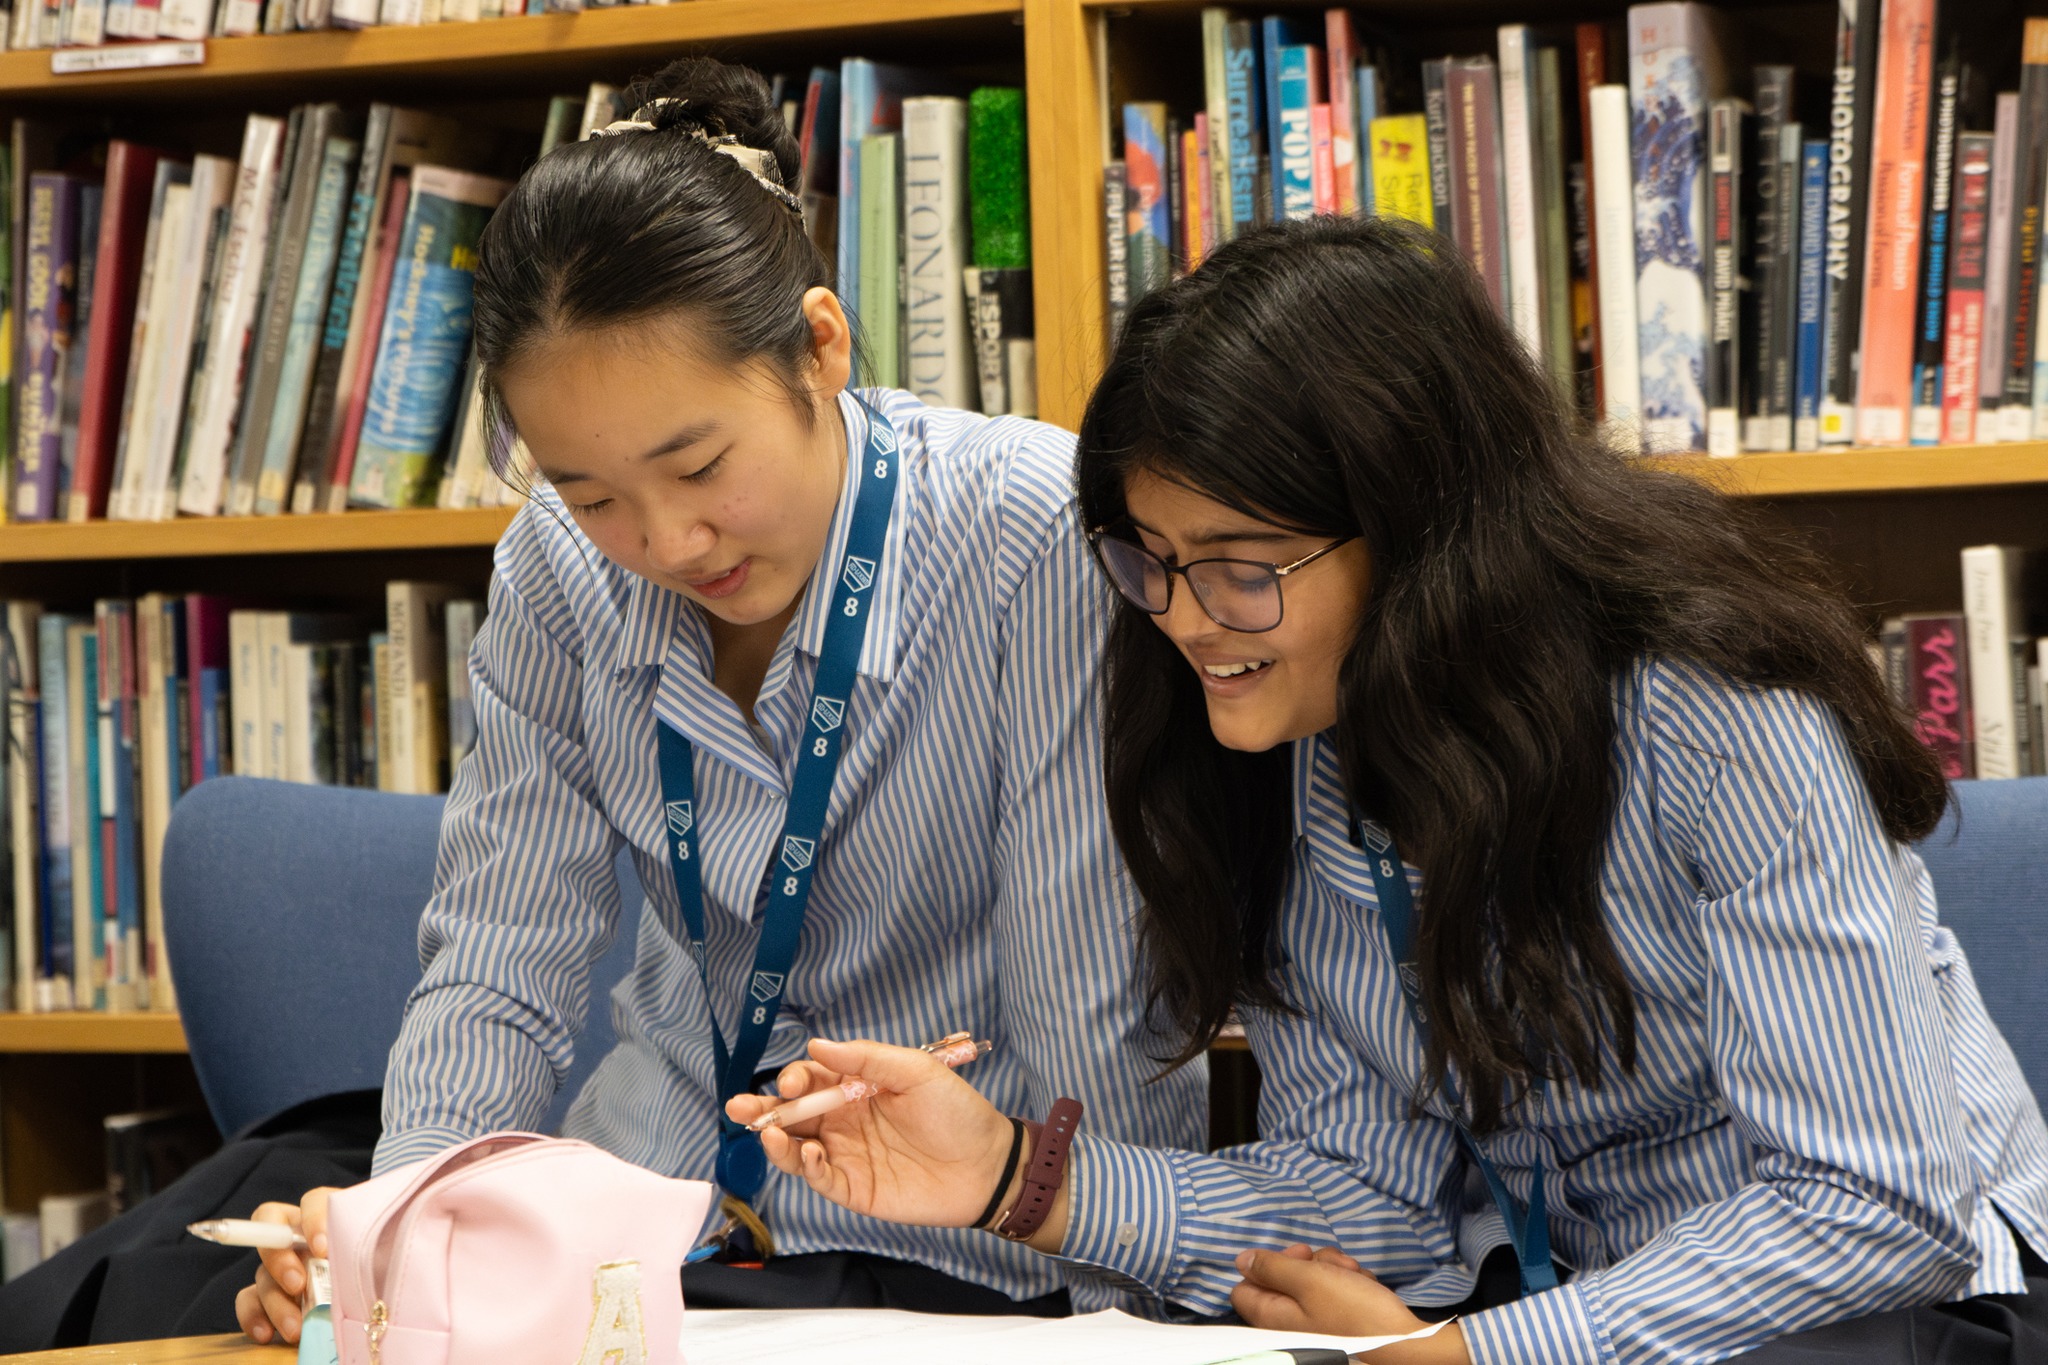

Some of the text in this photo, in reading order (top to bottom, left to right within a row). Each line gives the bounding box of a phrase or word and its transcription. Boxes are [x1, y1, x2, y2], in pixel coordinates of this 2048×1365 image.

[1227, 47, 1254, 223] Surrealism
[1281, 108, 1311, 181] POP
[1427, 88, 1450, 206] Kurt Jackson
[1932, 98, 1954, 211] PHOTOGRAPHERS
[1826, 66, 1856, 280] PHOTOGRAPHY
[1106, 183, 1128, 303] FUTURISM
[1931, 213, 1948, 242] YOU
[2019, 206, 2040, 264] Digital
[28, 252, 52, 311] COOK
[218, 225, 249, 307] Escher
[324, 194, 377, 350] Friedrich
[1714, 246, 1732, 289] DAVID
[1927, 244, 1946, 298] SHOULD
[381, 223, 436, 434] Hockney's Pictures
[1925, 300, 1943, 342] KNOW
[874, 460, 888, 479] 8
[843, 597, 859, 617] 8
[813, 737, 829, 757] 8
[678, 841, 691, 861] 8
[1378, 859, 1395, 878] 8
[783, 876, 799, 897] 8
[752, 1006, 766, 1025] 8
[575, 1259, 649, 1365] A
